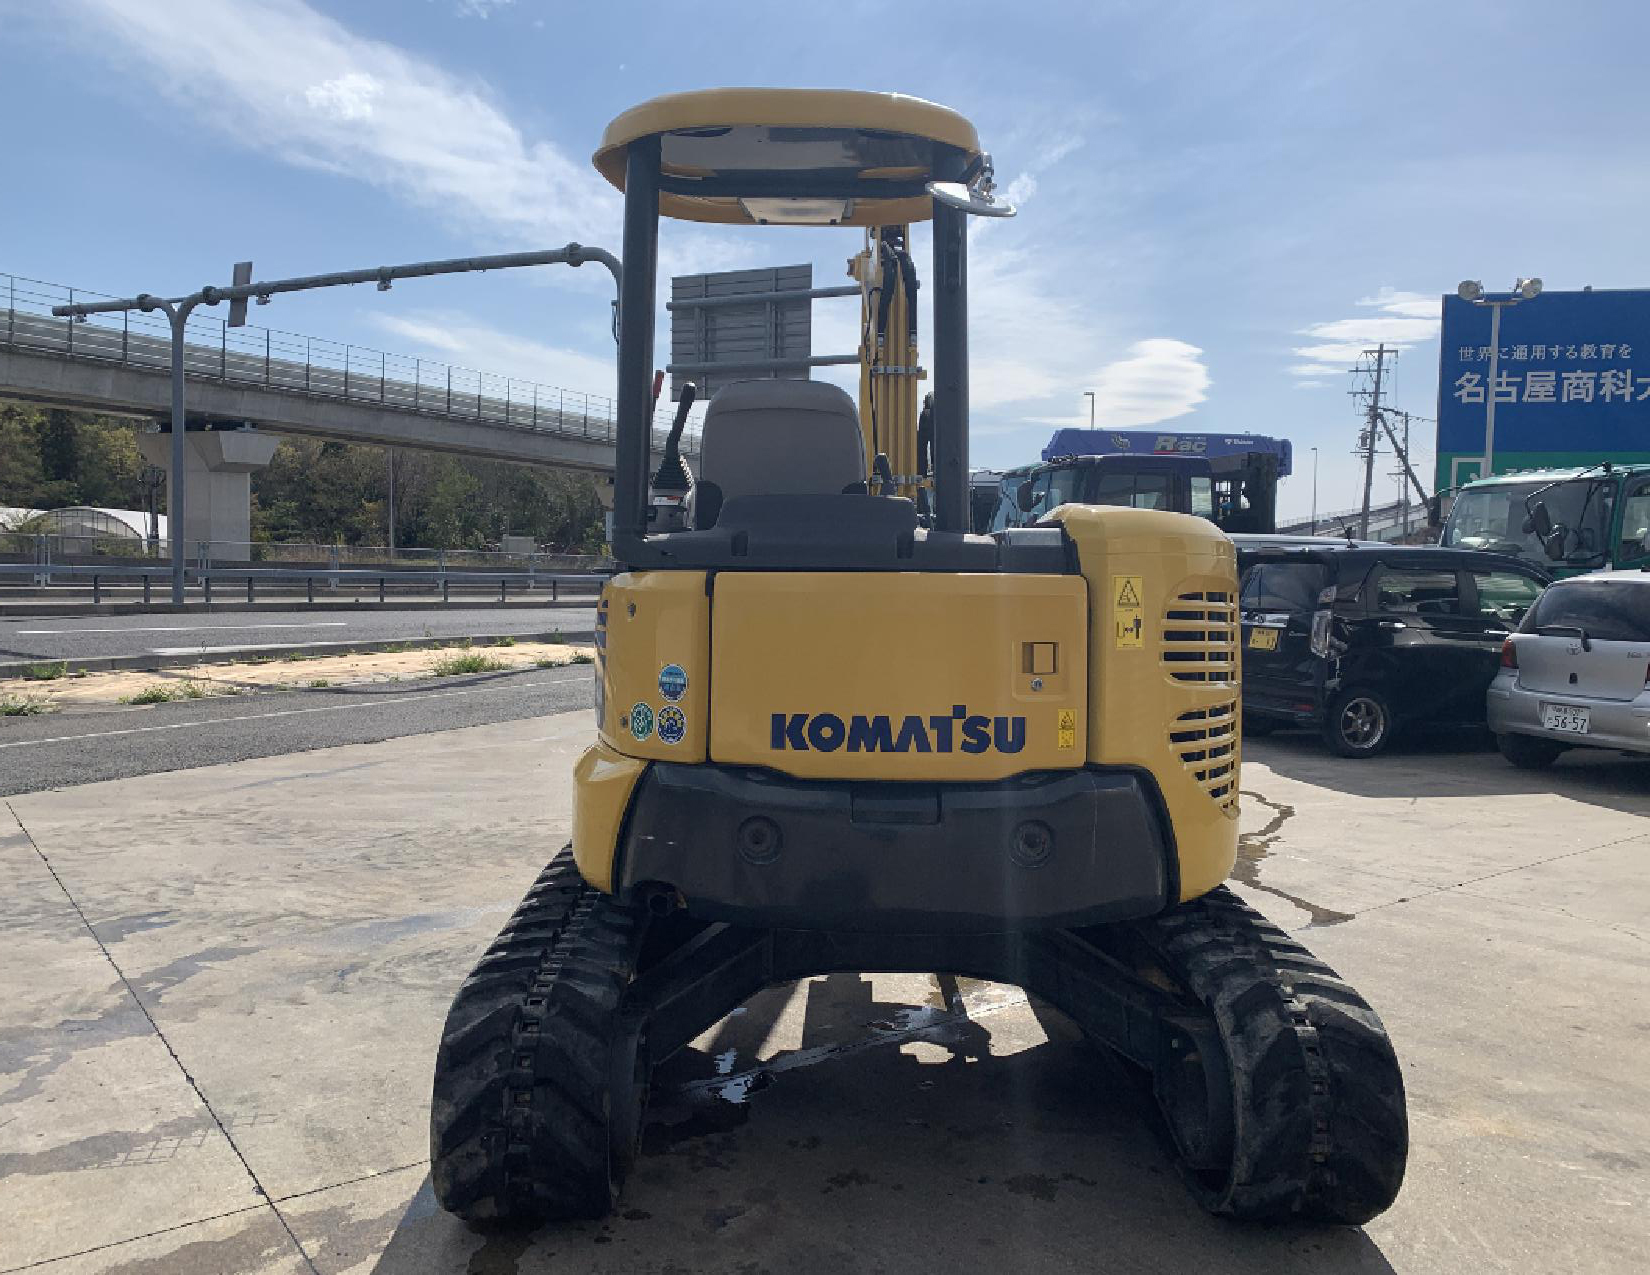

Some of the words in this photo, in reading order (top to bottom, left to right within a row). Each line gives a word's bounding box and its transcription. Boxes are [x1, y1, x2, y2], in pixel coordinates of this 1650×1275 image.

[1459, 343, 1633, 362] 世界に通用する教育を
[771, 705, 1026, 753] KOMATSU
[1553, 715, 1587, 731] 56-57
